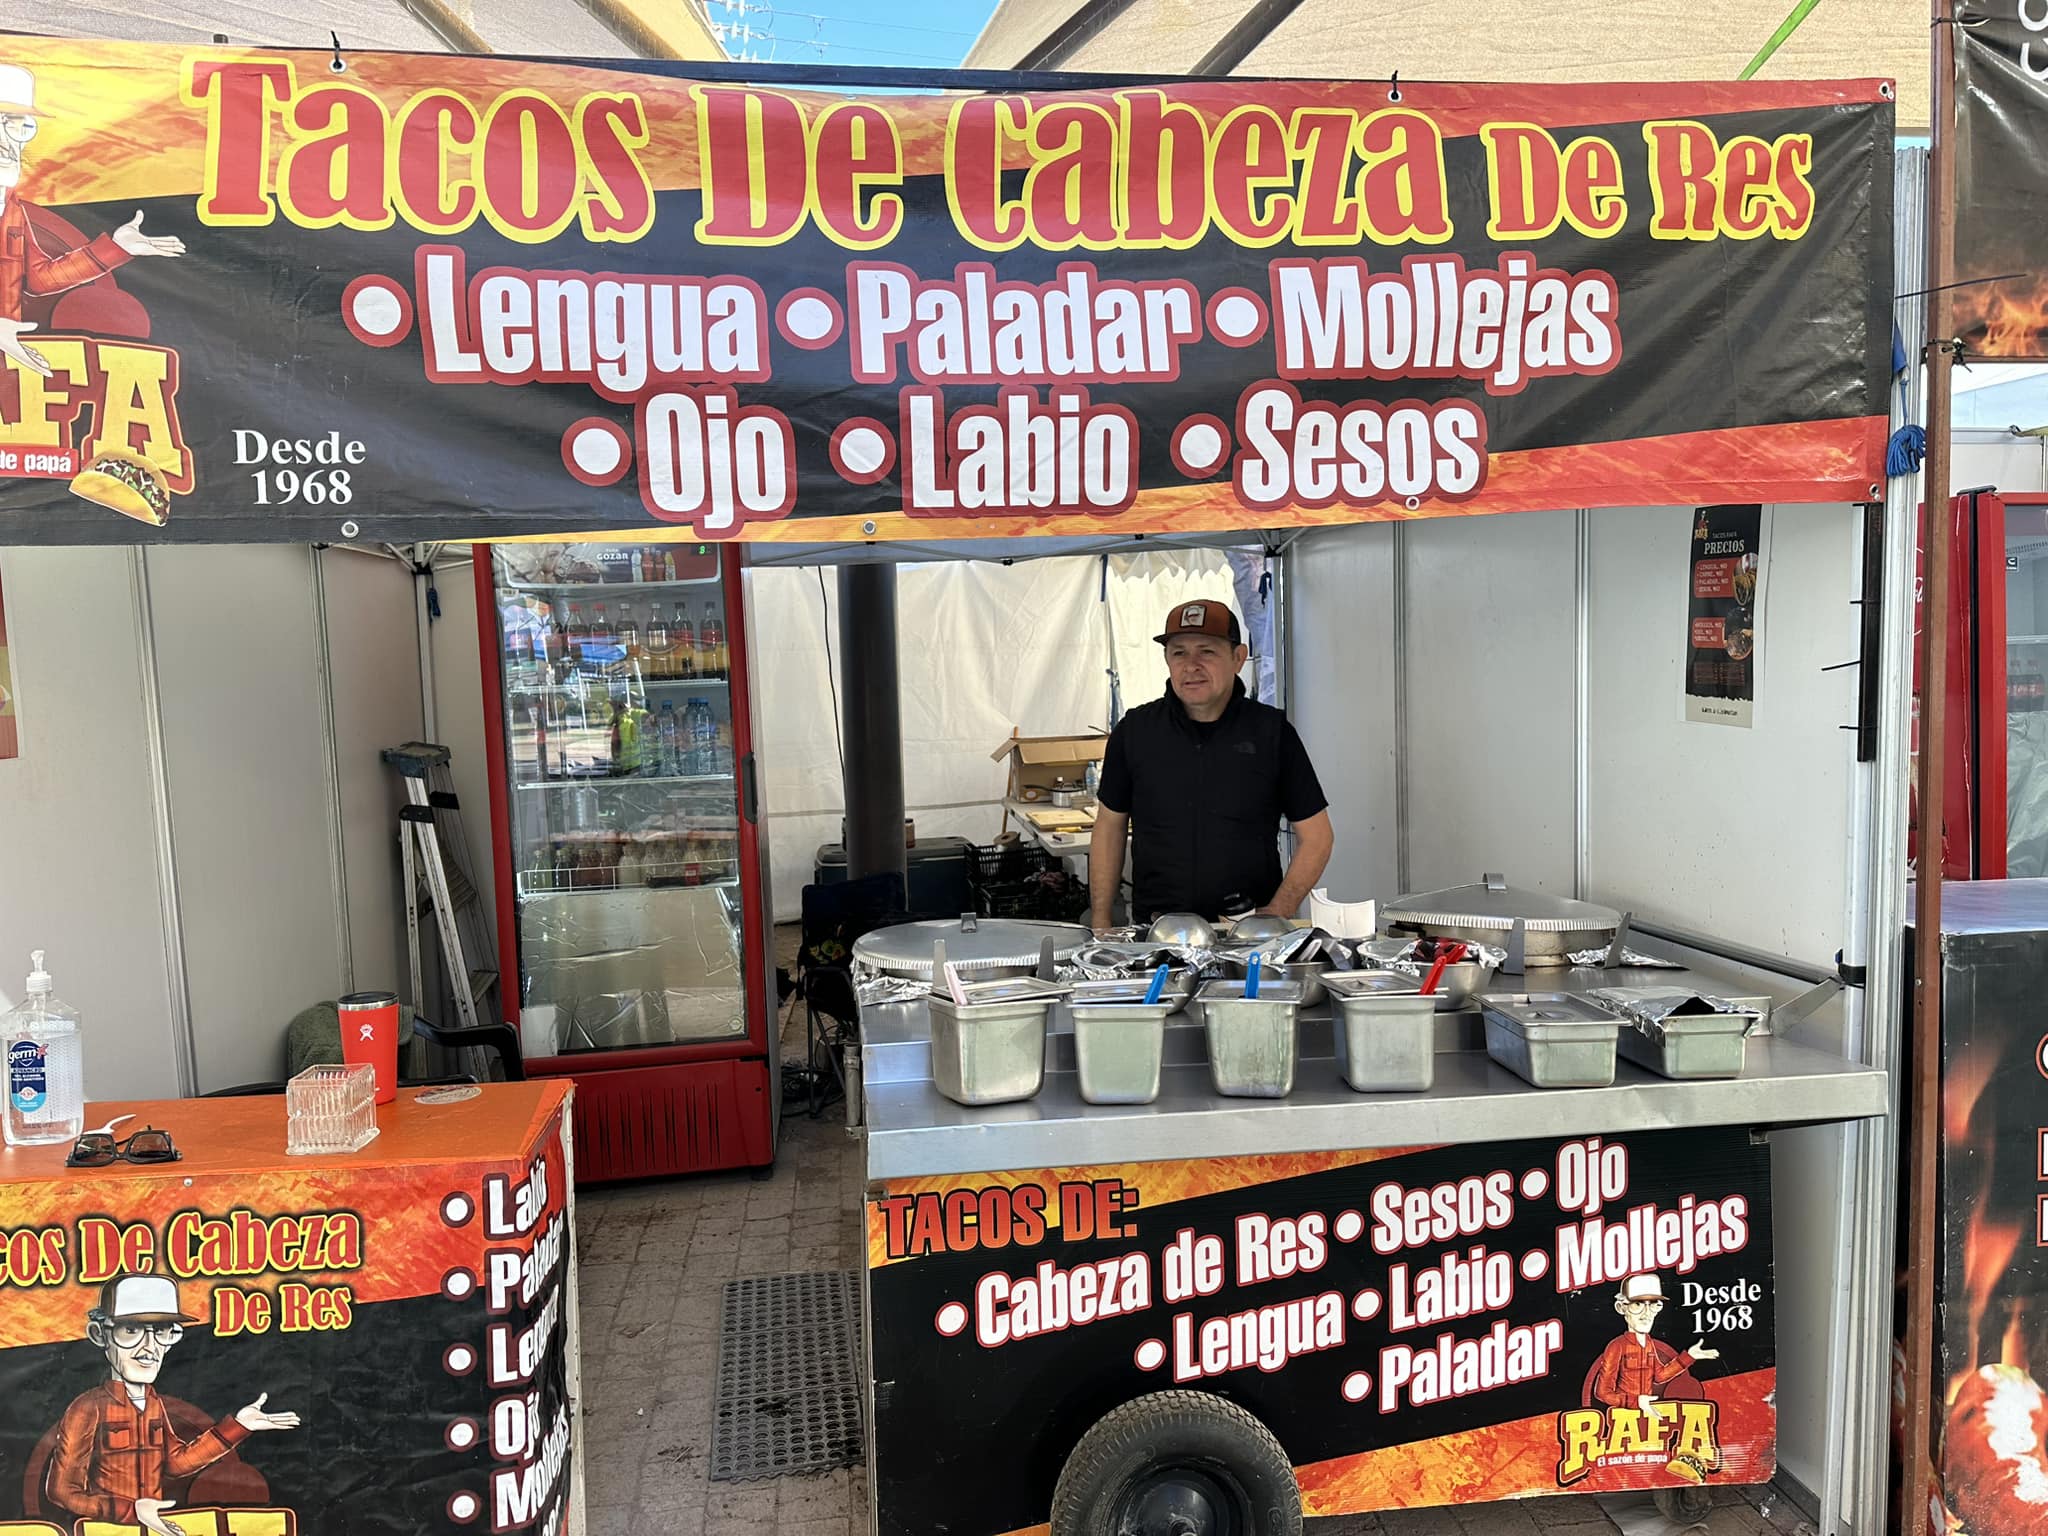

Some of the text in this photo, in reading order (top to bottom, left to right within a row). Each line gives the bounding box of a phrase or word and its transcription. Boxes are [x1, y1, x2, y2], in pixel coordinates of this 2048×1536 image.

[183, 57, 1814, 250] Tacos De Cabeza De Res
[424, 252, 1614, 392] Lengua Paladar Mollejas
[0, 340, 183, 477] FA
[24, 452, 71, 473] papá
[232, 429, 366, 466] Desde
[644, 388, 1481, 529] Ojo Labio Sesos
[251, 469, 353, 505] 1968
[1703, 540, 1745, 555] PRECIOS
[79, 1218, 154, 1282] De
[168, 1210, 361, 1277] Cabeza
[880, 1179, 1139, 1258] TACOS DE:
[977, 1138, 1627, 1347] Cabeza de Res Sesos Ojo
[214, 1283, 352, 1336] De Res
[1174, 1194, 1747, 1381] Lengua Labio Mollejas
[1682, 1279, 1761, 1308] Desde
[1692, 1306, 1753, 1334] 1968
[1380, 1319, 1562, 1413] Paladar
[494, 1391, 541, 1461] Ojo
[1564, 1402, 1715, 1475] RAFA
